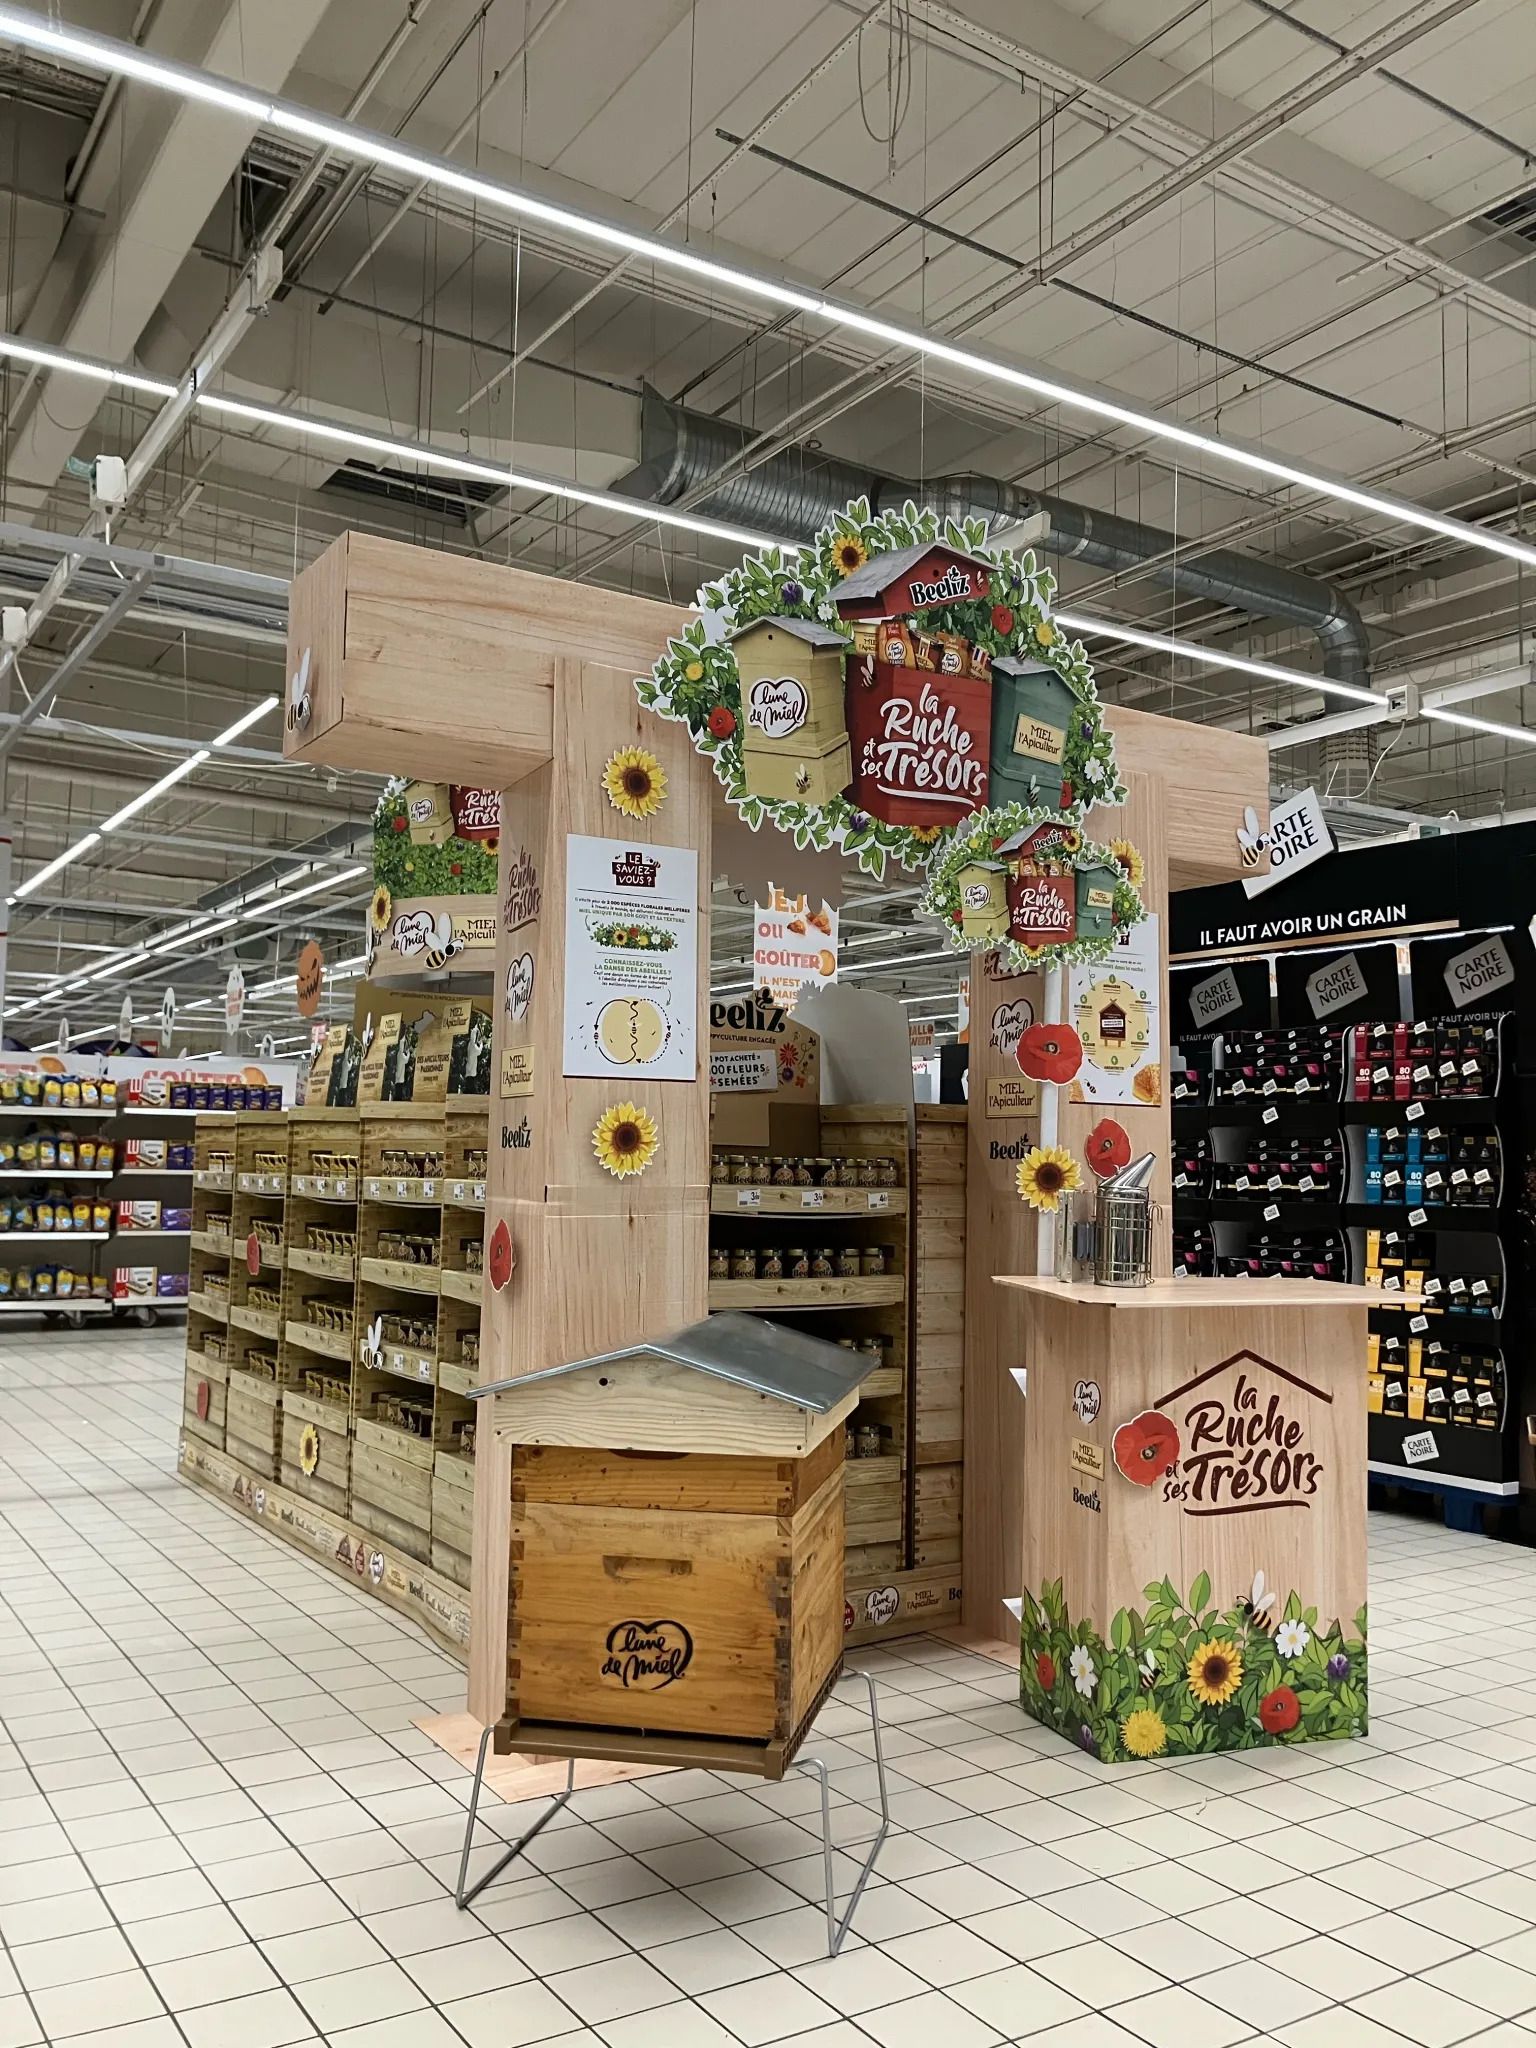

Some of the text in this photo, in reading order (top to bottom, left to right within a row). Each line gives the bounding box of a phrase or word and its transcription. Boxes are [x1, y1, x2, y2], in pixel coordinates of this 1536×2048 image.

[910, 570, 971, 605] Beeliz
[759, 685, 791, 705] lune
[919, 682, 939, 715] la
[750, 707, 762, 724] de
[880, 698, 973, 755] Ruche
[1030, 724, 1054, 743] MIEL
[863, 738, 876, 758] et
[1018, 731, 1062, 755] l'Apiculteur
[860, 758, 881, 779] ses
[1270, 806, 1312, 845] RTE
[1032, 831, 1063, 850] Beeliz
[1270, 826, 1319, 867] OIRE
[629, 854, 641, 864] LE
[615, 864, 655, 875] SAVIEZ-
[619, 875, 652, 886] VOUS ?
[1020, 888, 1066, 910] Ruche
[398, 919, 424, 937] lune
[1200, 904, 1407, 946] IL FAUT AVOIR UN GRAIN
[604, 958, 663, 968] CONNAISSEZ-VOUS
[755, 948, 820, 969] GOÛTER
[1455, 947, 1501, 979] CARTE
[760, 976, 770, 985] IL
[1315, 964, 1355, 993] CARTE
[1459, 961, 1506, 993] NOIRE
[772, 989, 798, 999] MAIS
[1197, 978, 1232, 1005] CARTE
[1319, 976, 1360, 1006] NOIRE
[1200, 990, 1236, 1016] NOIRE
[710, 996, 785, 1033] eeliz
[998, 1008, 1023, 1029] lune
[510, 1055, 527, 1069] MIEL
[730, 1053, 755, 1062] ACHETÉ
[727, 1063, 765, 1074] FLEURS
[1360, 1068, 1370, 1076] 80
[1399, 1067, 1410, 1075] 80
[999, 1083, 1025, 1094] MIEL
[989, 1095, 1035, 1110] l'Apiculteur
[502, 1120, 531, 1149] Beeliz
[1370, 1171, 1381, 1179] 80
[1411, 1172, 1422, 1180] 80
[1234, 1375, 1257, 1411] la
[1184, 1394, 1304, 1452] Ruche
[1079, 1443, 1096, 1458] MIEL
[1408, 1437, 1431, 1450] CARTE
[1410, 1445, 1434, 1457] NOIRE
[1073, 1487, 1101, 1513] Beeliz
[1162, 1480, 1188, 1502] ses
[872, 1593, 891, 1608] lune
[914, 1590, 934, 1600] MIEL
[618, 1627, 671, 1653] lune
[601, 1656, 622, 1677] de
